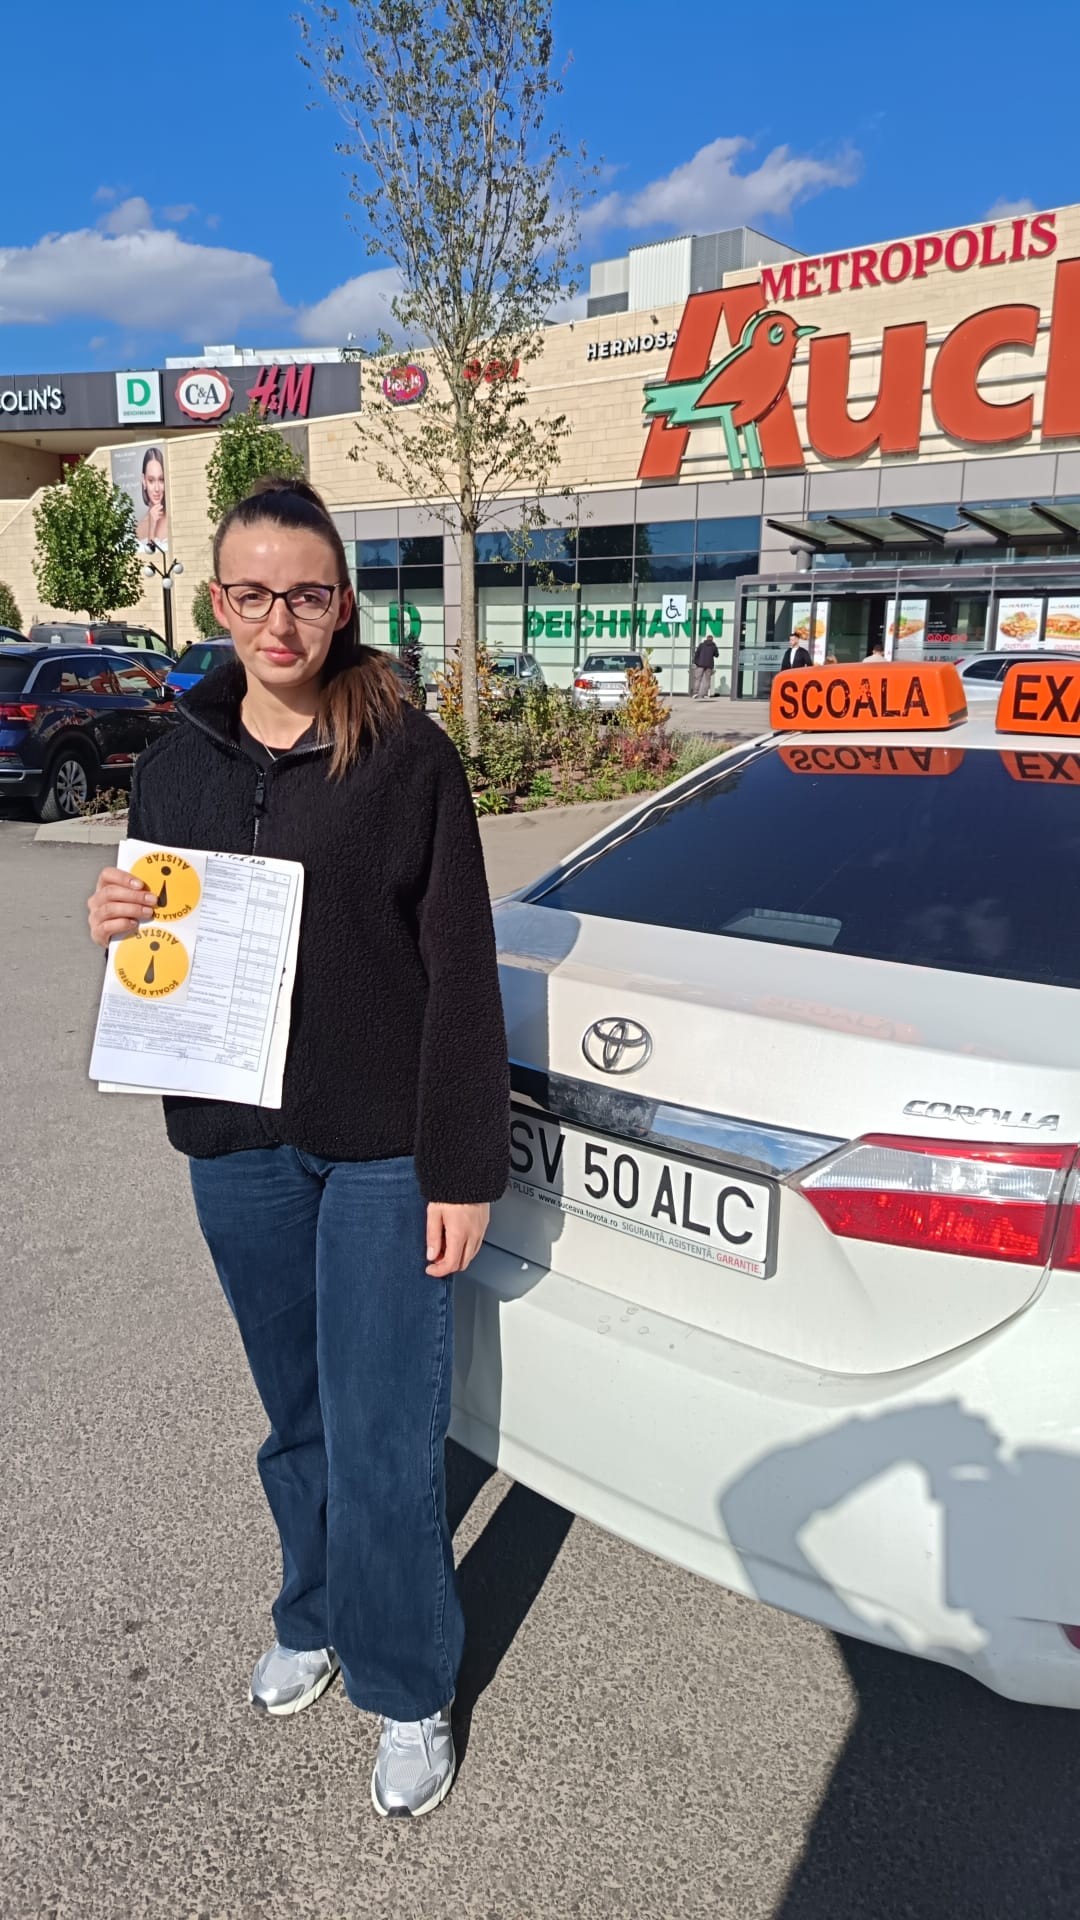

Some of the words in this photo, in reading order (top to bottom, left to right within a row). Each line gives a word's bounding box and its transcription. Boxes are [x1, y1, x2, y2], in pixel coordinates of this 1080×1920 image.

[760, 213, 1058, 303] METROPOLIS
[0, 385, 62, 412] OLIN'S
[127, 379, 151, 407] D
[185, 383, 221, 405] C&A
[246, 363, 313, 417] H&M
[526, 608, 724, 638] DEICHMANN
[779, 675, 930, 721] SCOALA
[1012, 674, 1080, 723] EX
[145, 853, 190, 870] ALISTAR
[902, 1099, 1060, 1132] COROLLA
[509, 1119, 566, 1184] SV
[584, 1142, 640, 1209] 50
[650, 1165, 755, 1245] ALC
[512, 1182, 535, 1197] PLUS
[538, 1193, 618, 1228] www.suceava.toyota.ro
